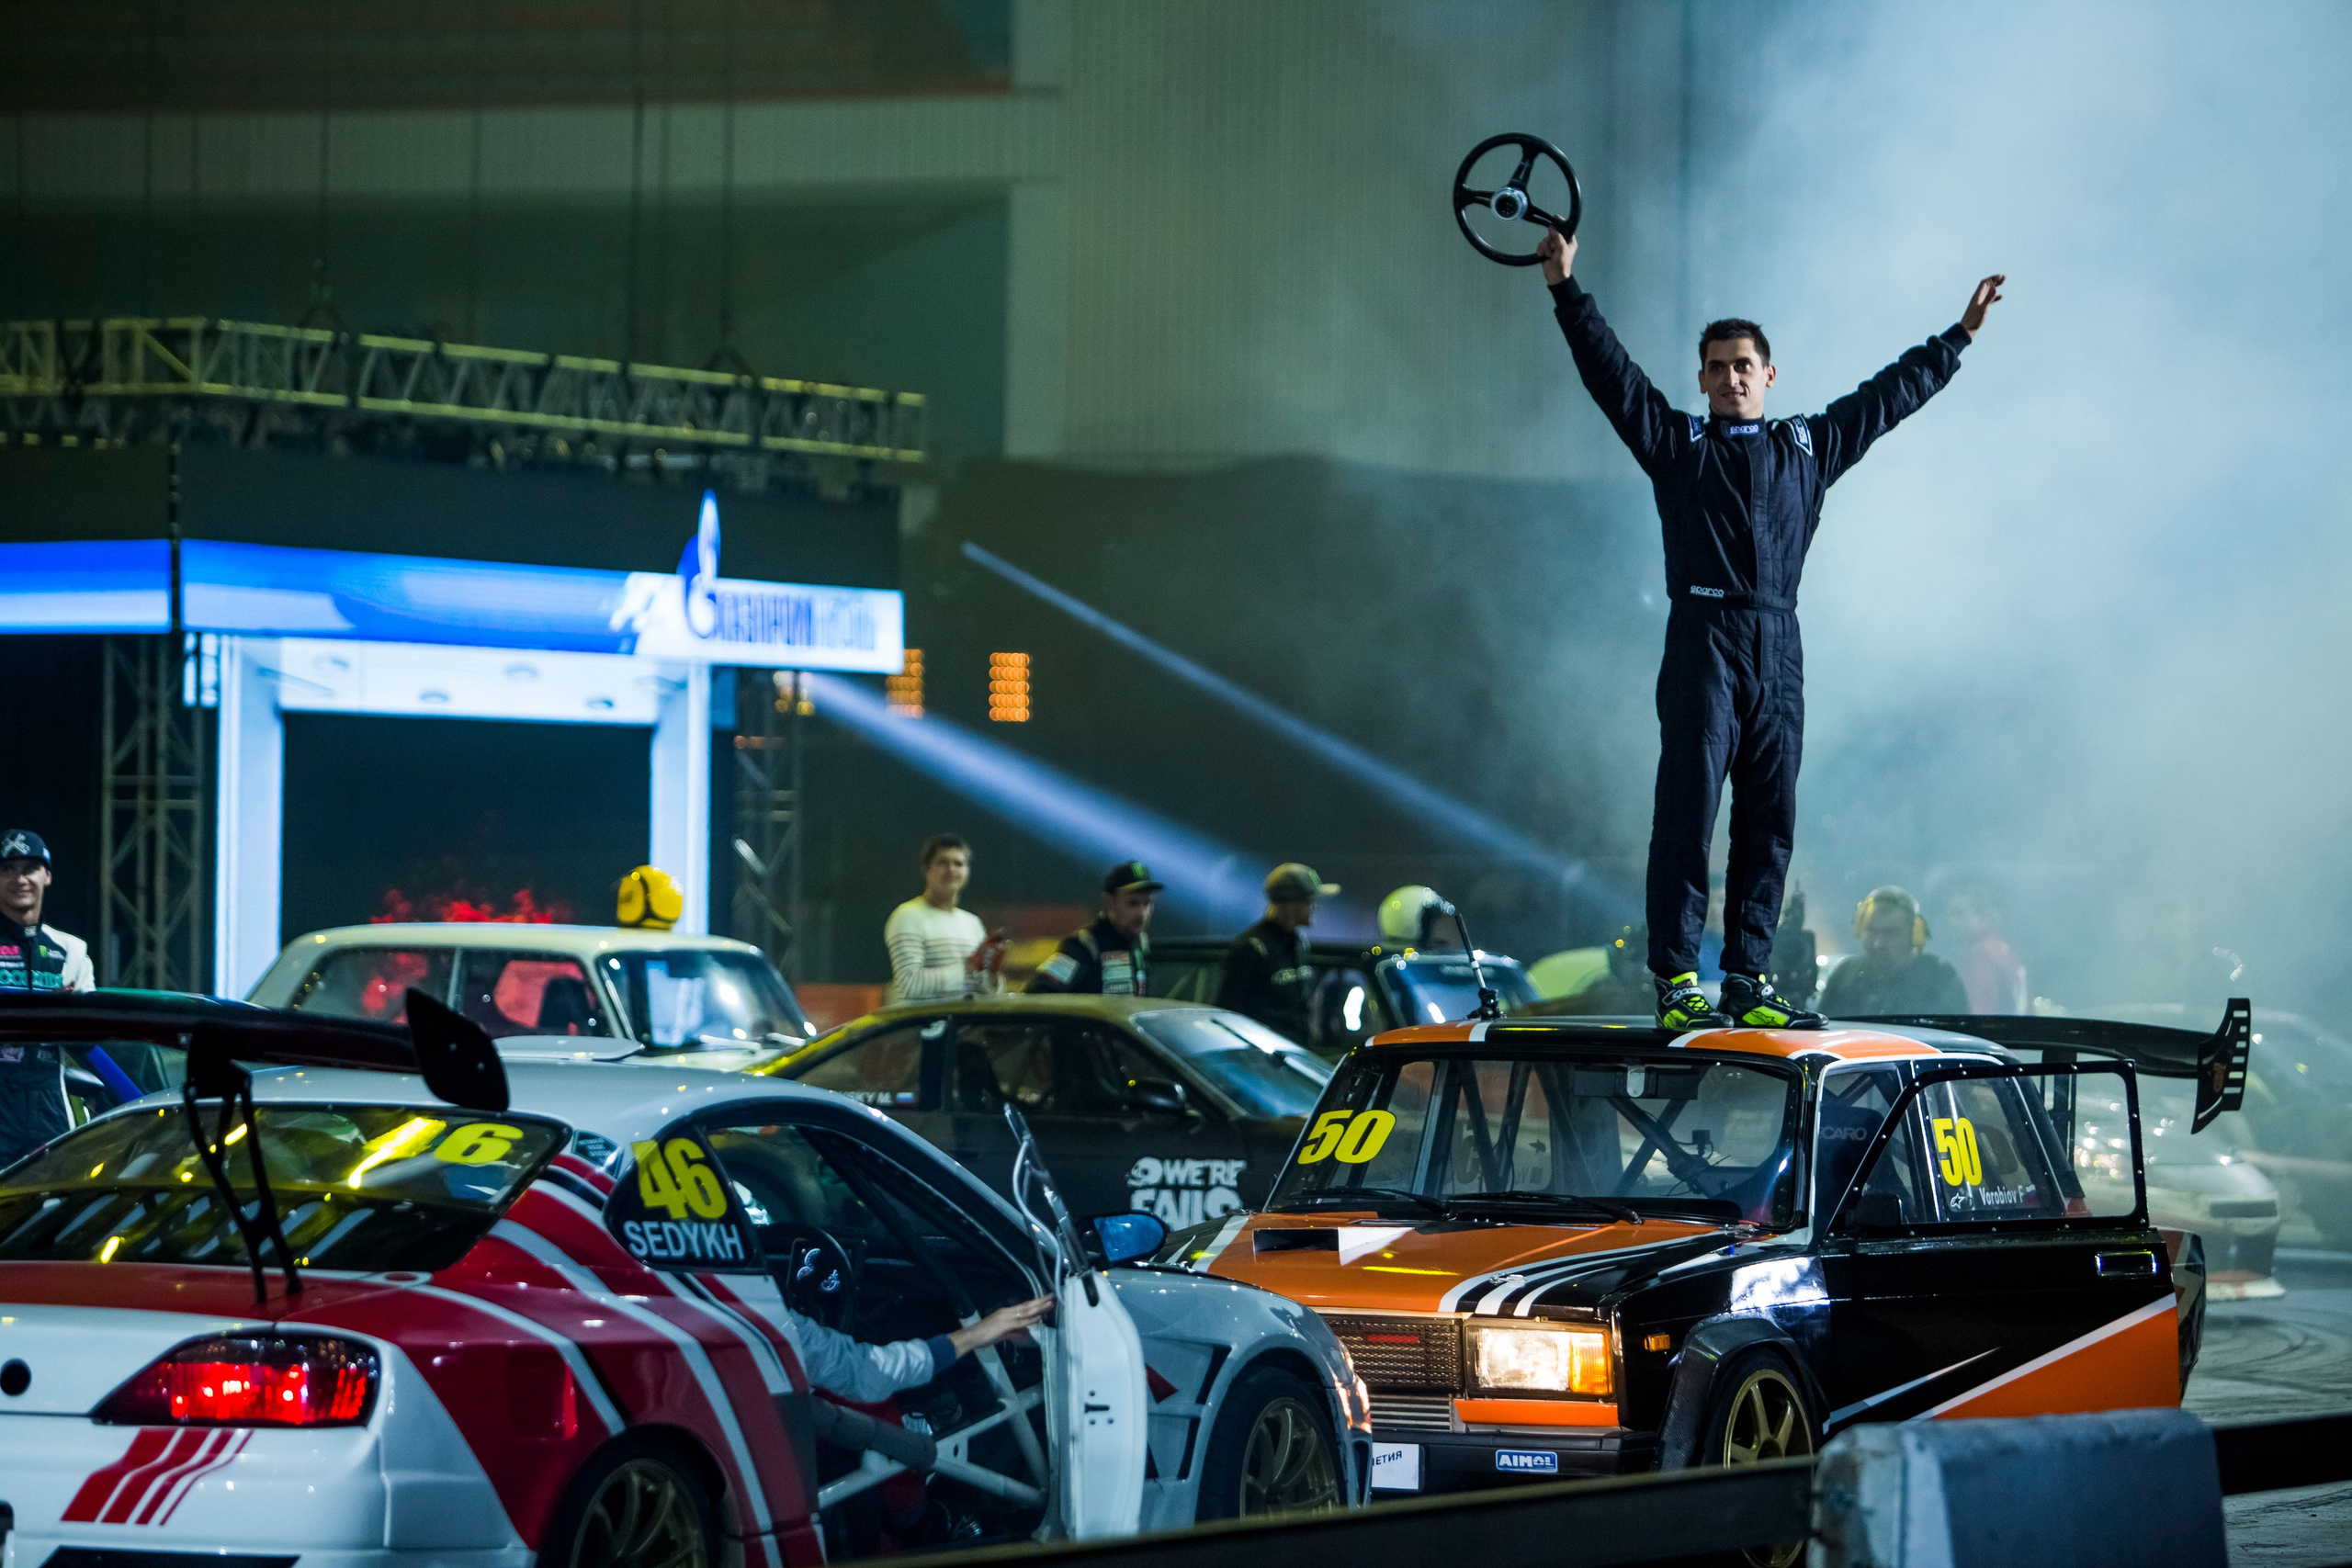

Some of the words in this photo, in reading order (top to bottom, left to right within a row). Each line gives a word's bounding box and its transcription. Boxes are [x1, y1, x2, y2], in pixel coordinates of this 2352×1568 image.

[1690, 585, 1724, 597] sparco
[1297, 1110, 1396, 1165] 50
[1819, 1125, 1867, 1140] CARO
[1932, 1117, 1983, 1186] 50
[630, 1137, 728, 1220] 46
[1979, 1186, 2017, 1205] Vorobiov
[623, 1220, 745, 1260] SEDYKH
[1498, 1454, 1555, 1468] AIMOL
